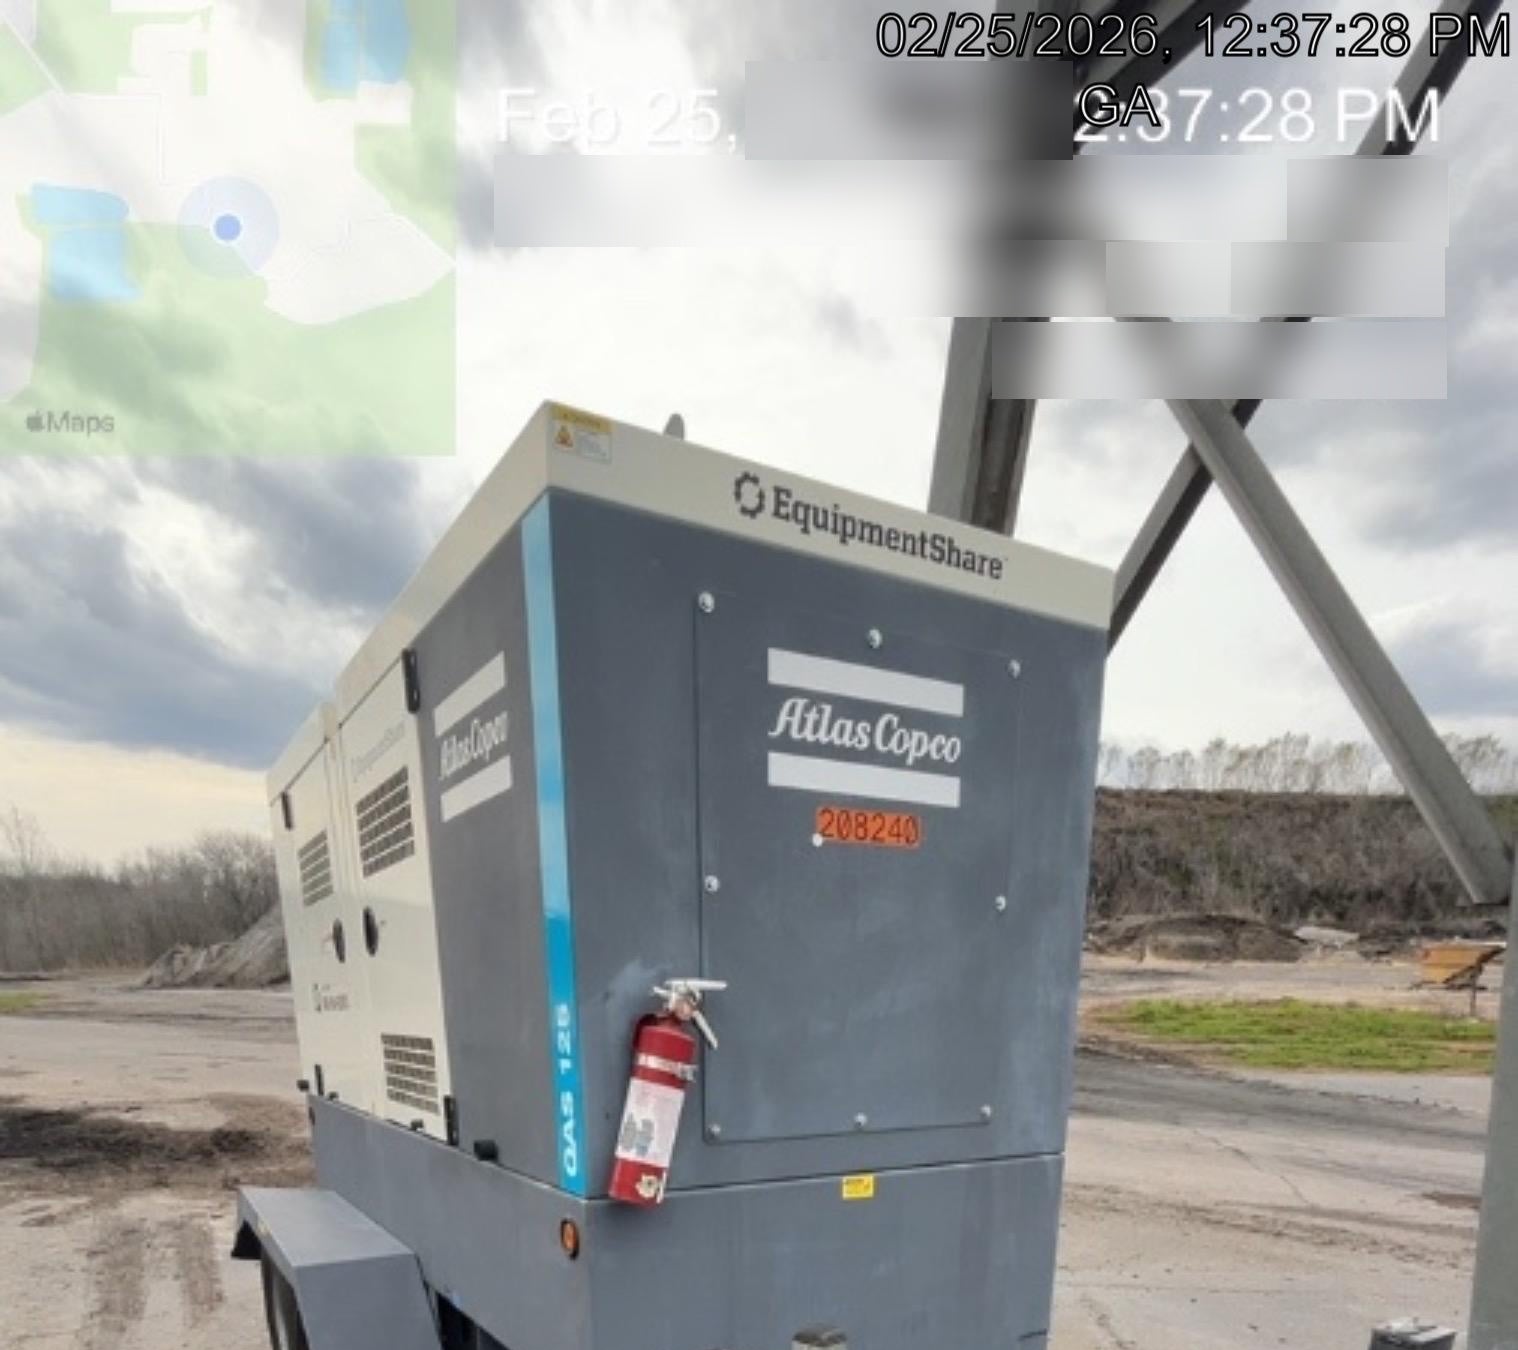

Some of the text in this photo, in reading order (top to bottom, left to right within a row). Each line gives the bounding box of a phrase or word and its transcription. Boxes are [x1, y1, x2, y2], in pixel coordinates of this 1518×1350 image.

[772, 485, 1004, 579] EquipmentShare
[768, 697, 962, 766] Atlas Copco
[819, 807, 919, 844] 208240
